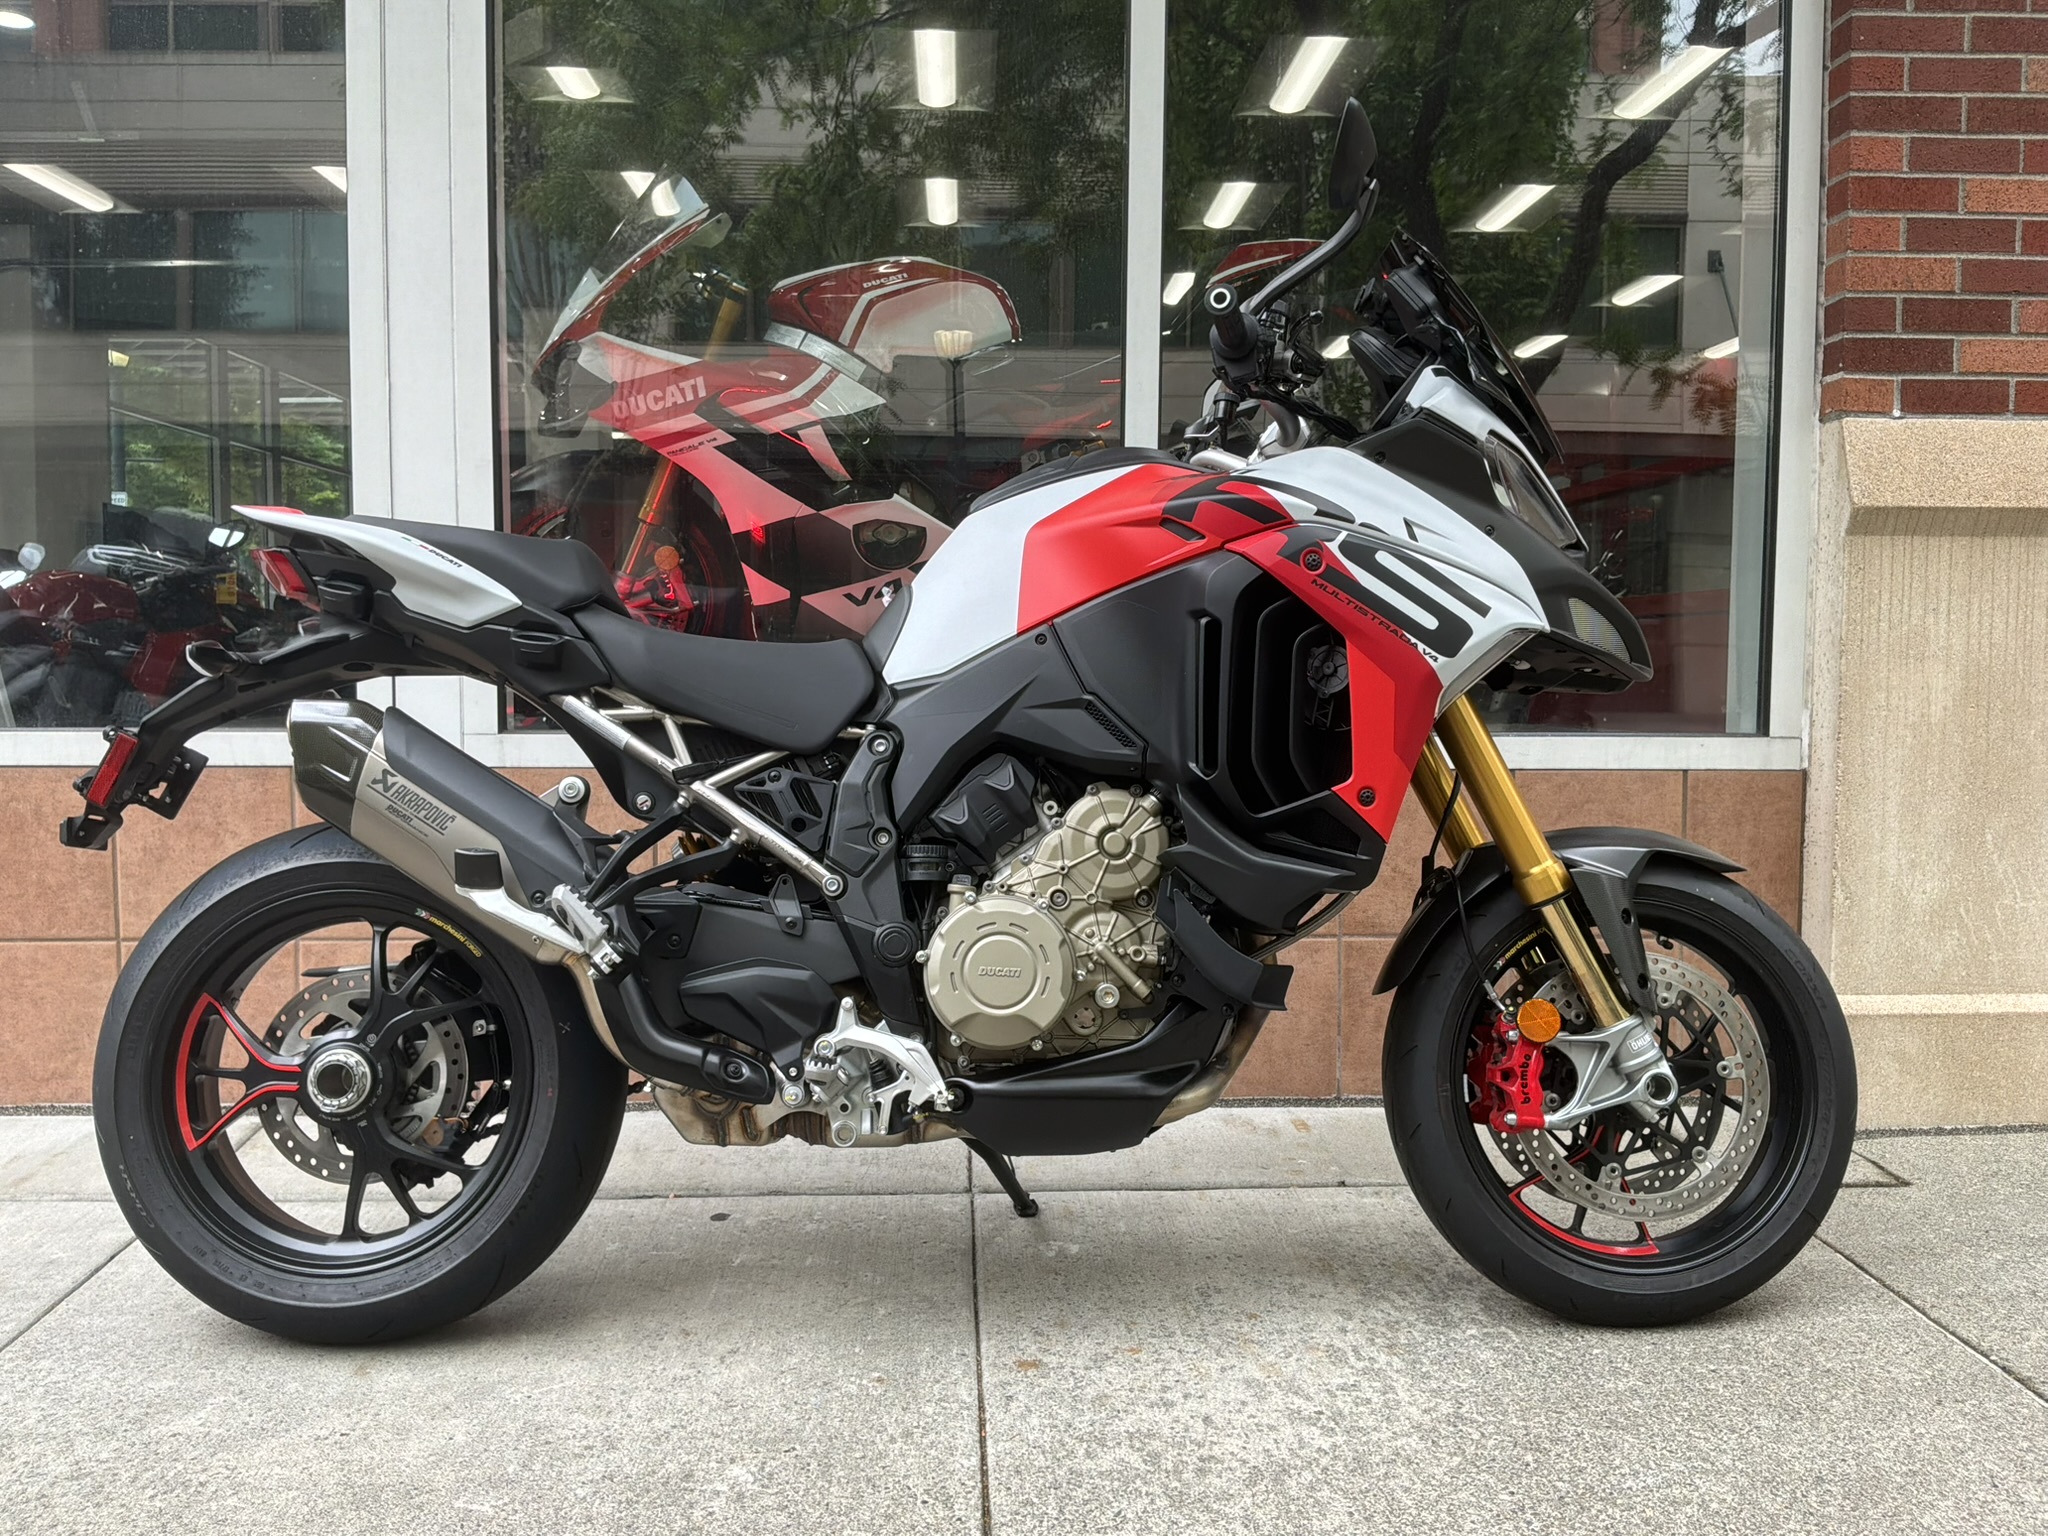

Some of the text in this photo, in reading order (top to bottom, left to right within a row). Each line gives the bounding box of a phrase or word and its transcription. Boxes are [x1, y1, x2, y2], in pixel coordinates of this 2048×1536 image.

[862, 273, 909, 288] DUCATI
[612, 376, 706, 419] DUCATI
[429, 549, 463, 568] DUCATI
[842, 577, 903, 607] V4
[1311, 579, 1440, 663] MULTISTRADA V4
[385, 804, 413, 823] DUCATI
[390, 784, 457, 831] AKRAPOVIČ
[429, 916, 467, 943] marchesini
[1505, 930, 1538, 959] marchesini
[978, 966, 1021, 978] DUCATI
[1519, 1053, 1532, 1105] brembo
